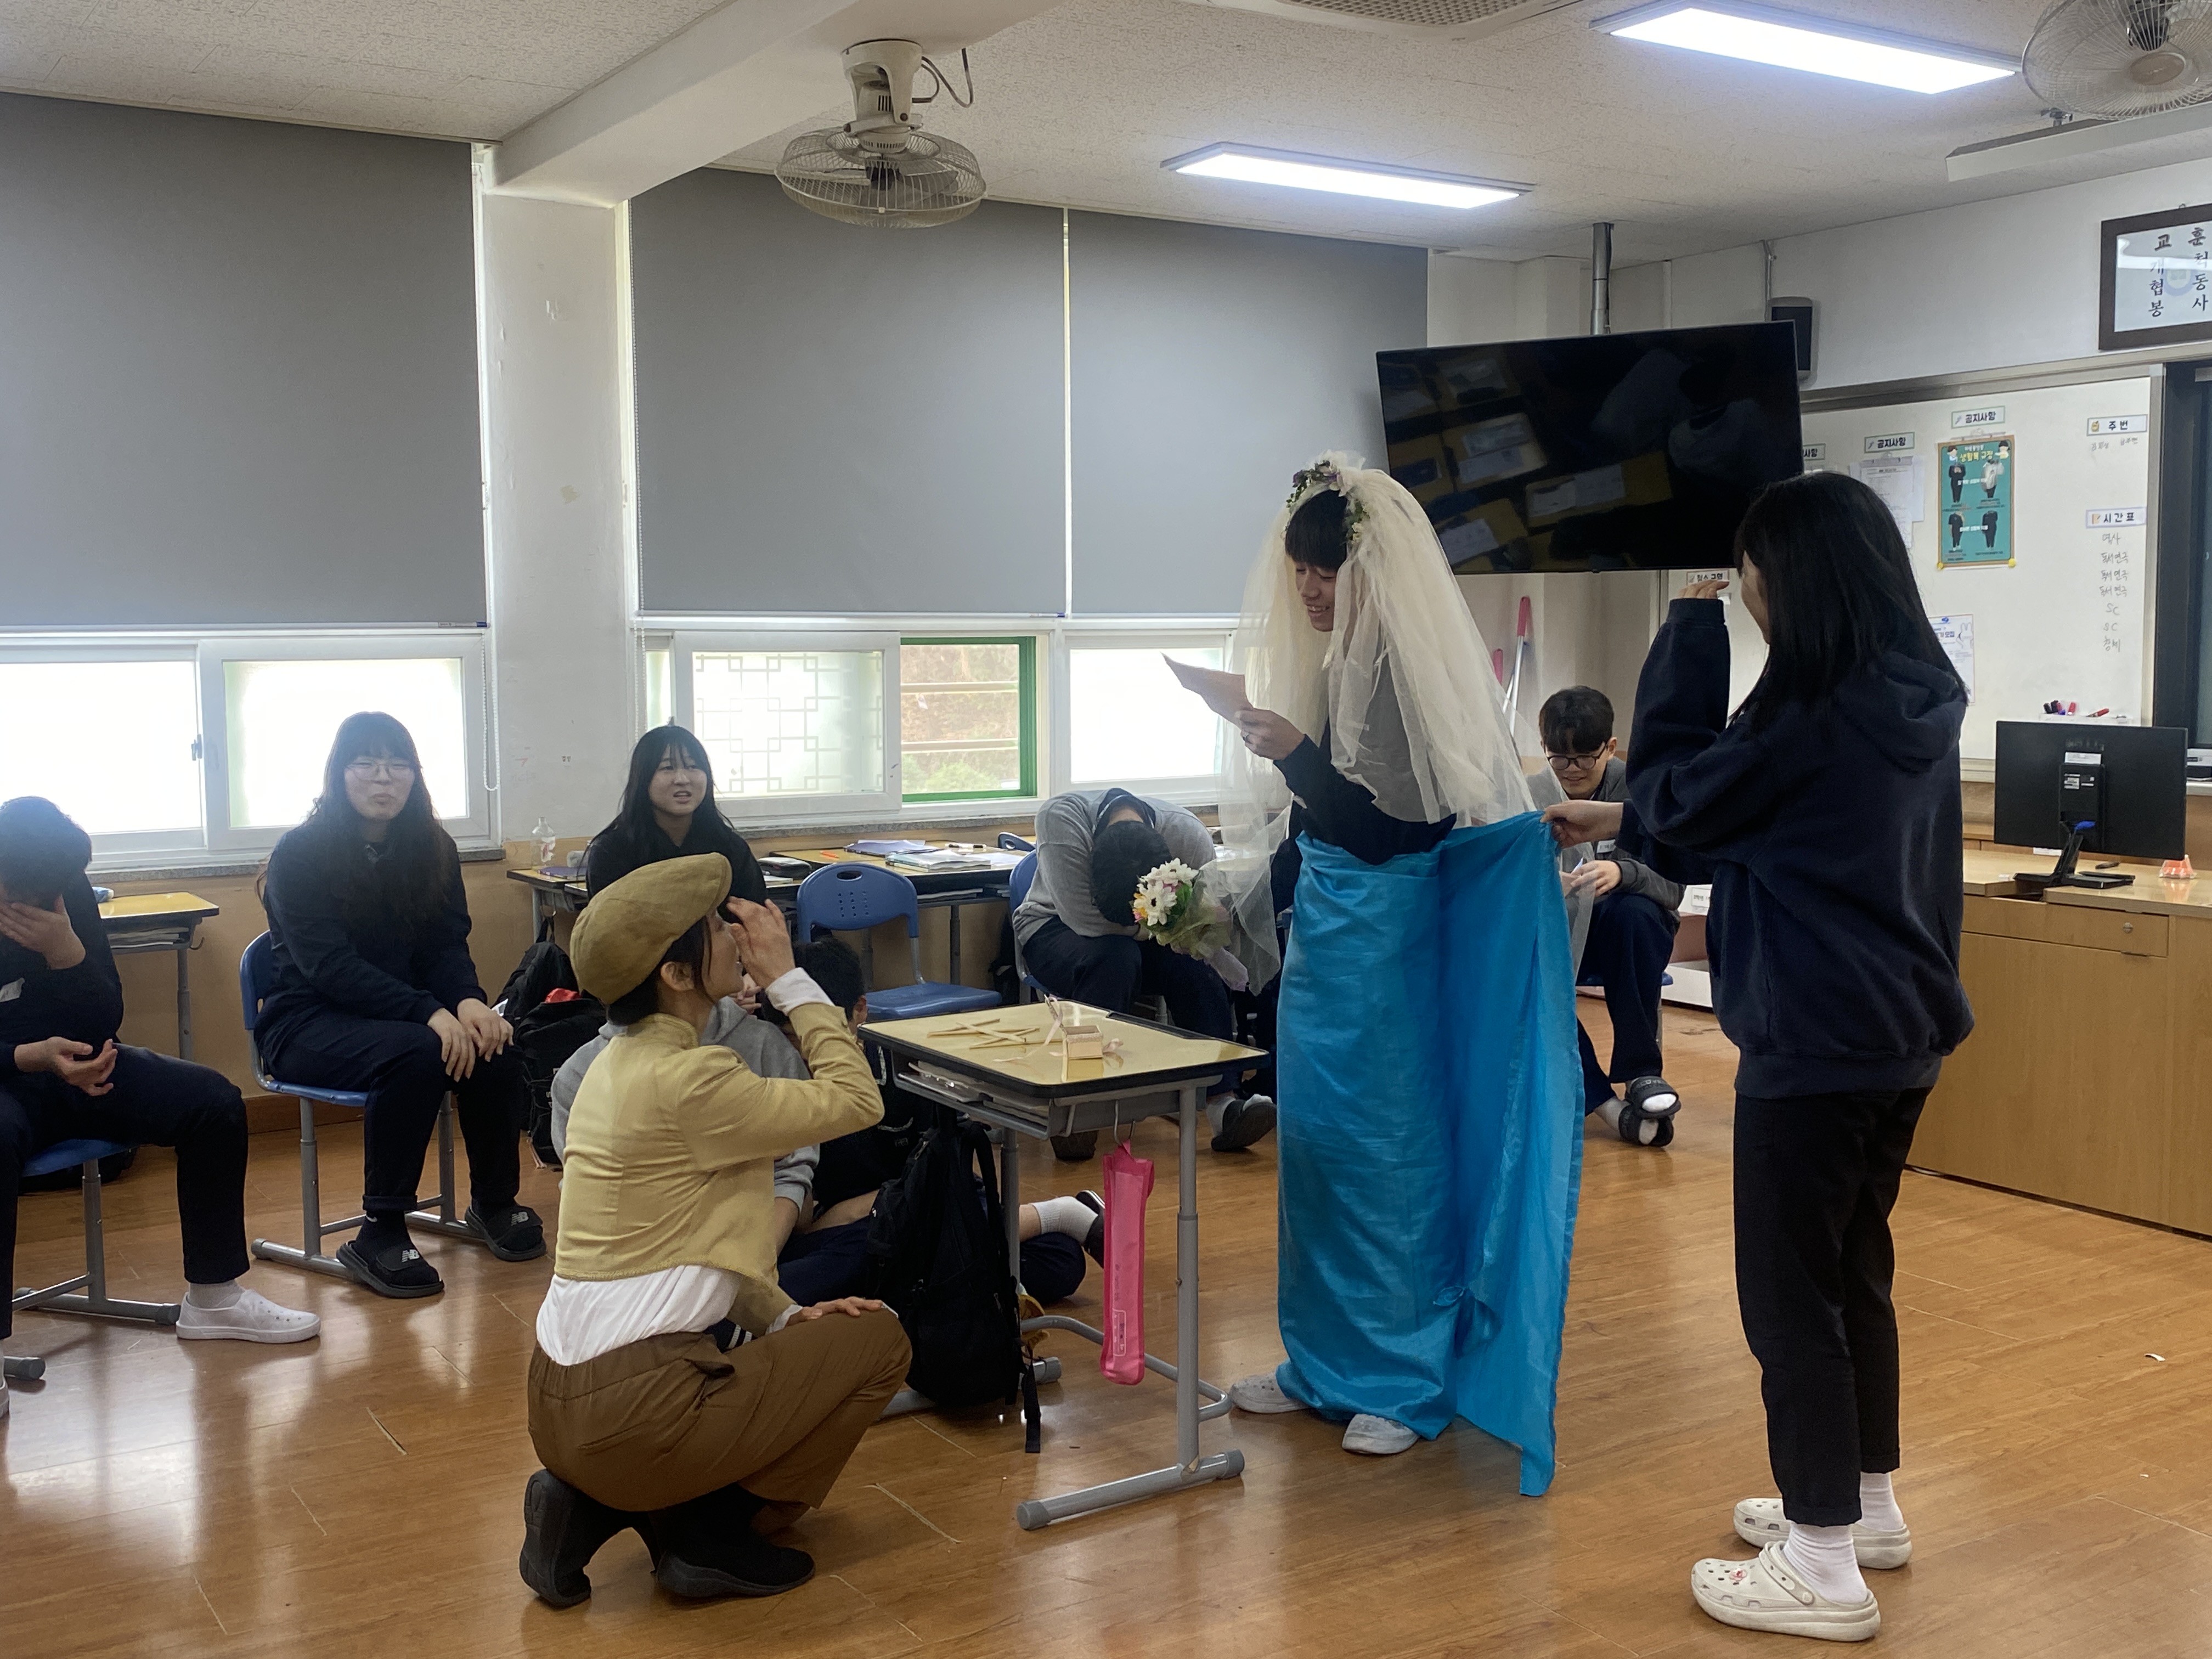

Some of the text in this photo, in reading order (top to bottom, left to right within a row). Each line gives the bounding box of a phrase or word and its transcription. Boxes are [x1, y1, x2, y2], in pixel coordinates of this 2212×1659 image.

[1965, 411, 1996, 424] 공지사항
[1877, 437, 1906, 449] 공지사항
[1802, 448, 1818, 458] 사항
